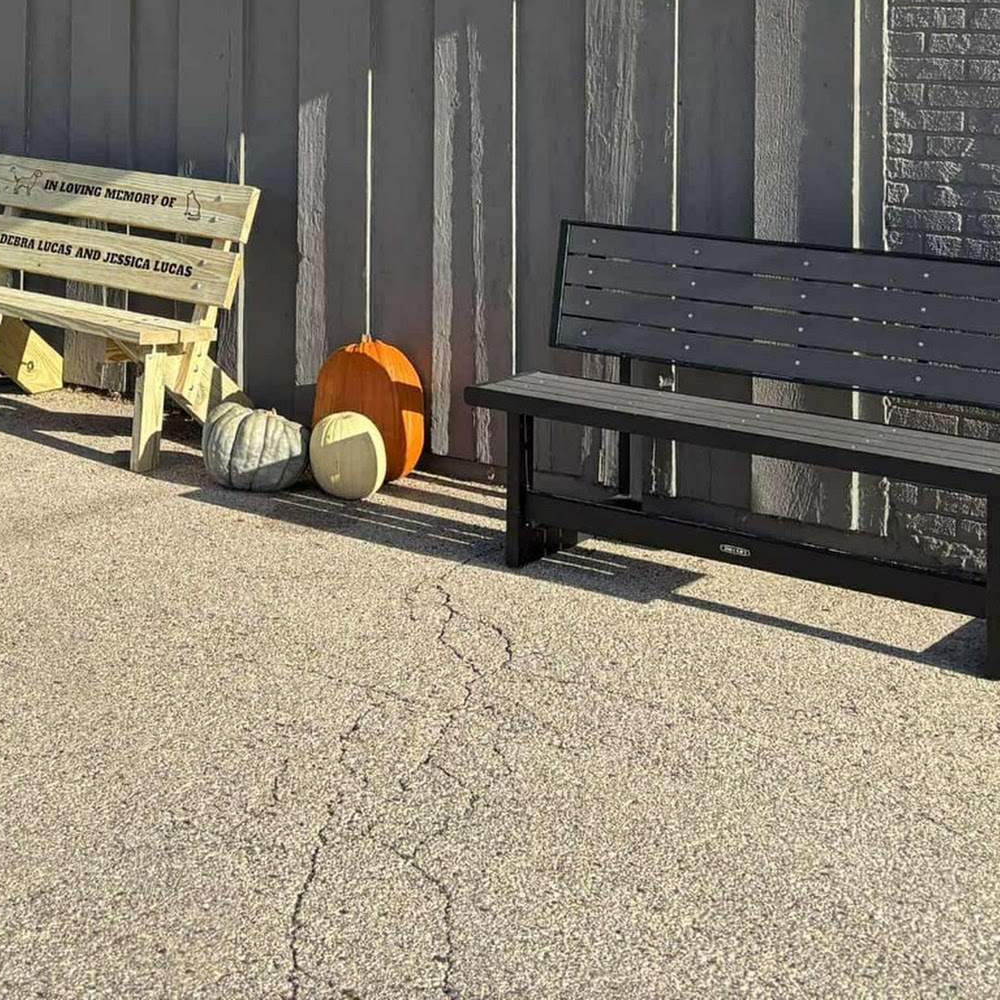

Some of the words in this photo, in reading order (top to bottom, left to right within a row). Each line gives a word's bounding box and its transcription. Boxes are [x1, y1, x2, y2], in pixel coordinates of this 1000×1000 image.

[43, 179, 59, 192] IN
[59, 181, 102, 198] LOVING
[104, 187, 159, 206] MEMORY
[160, 195, 178, 208] OF
[0, 233, 36, 250] DEBRA
[37, 239, 73, 256] LUCAS
[75, 247, 102, 261] AND
[102, 251, 151, 270] JESSICA
[152, 259, 193, 277] LUCAS
